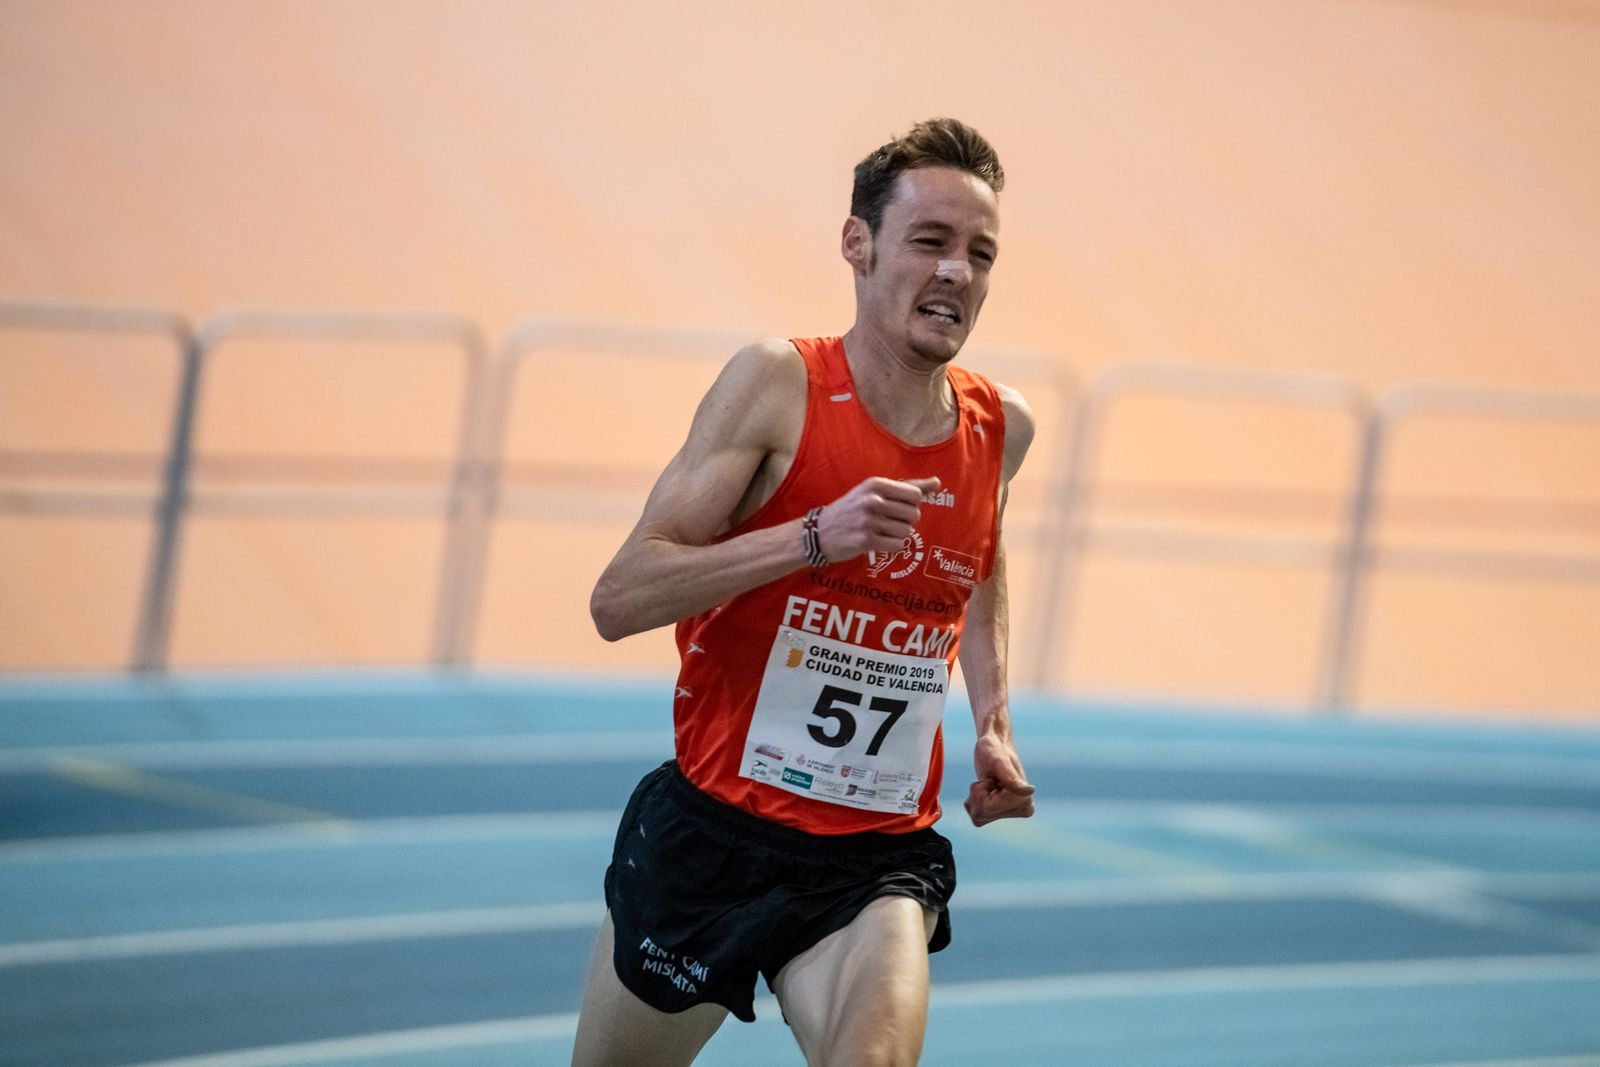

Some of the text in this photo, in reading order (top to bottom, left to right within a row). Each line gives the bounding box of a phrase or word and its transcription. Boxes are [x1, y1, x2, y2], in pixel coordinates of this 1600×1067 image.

[783, 595, 876, 645] FENT
[805, 658, 944, 695] CIUDAD DE VALENCIA
[809, 645, 935, 680] GRAN PREMIO 2019
[806, 684, 909, 757] 57
[642, 958, 697, 994] MISLATA
